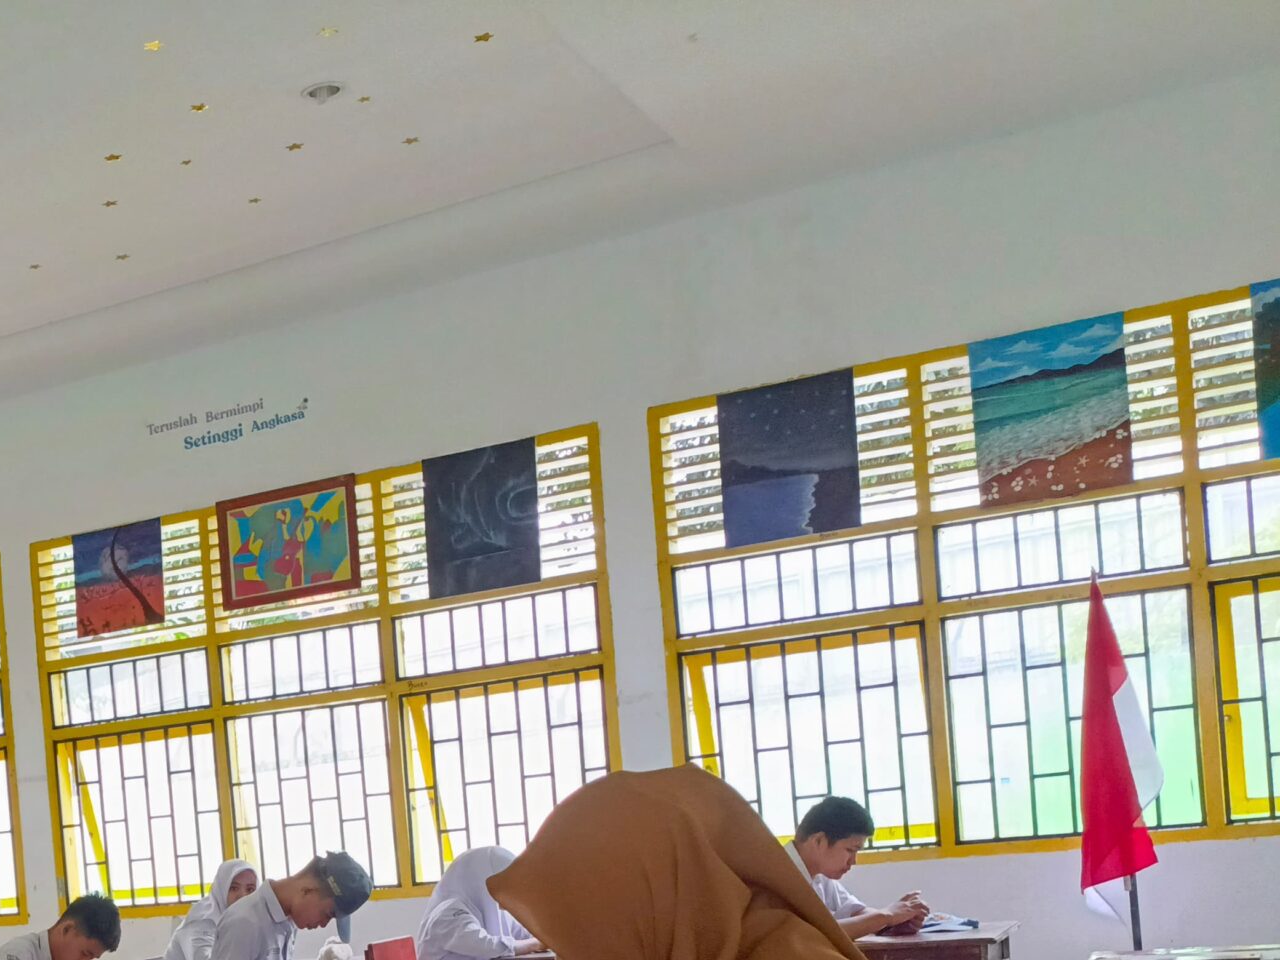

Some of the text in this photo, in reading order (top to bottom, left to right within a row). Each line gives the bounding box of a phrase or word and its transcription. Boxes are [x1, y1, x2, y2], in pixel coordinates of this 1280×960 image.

[147, 398, 264, 436] Teruslah Bermimpi
[184, 410, 305, 450] Setinggi Angkasa
